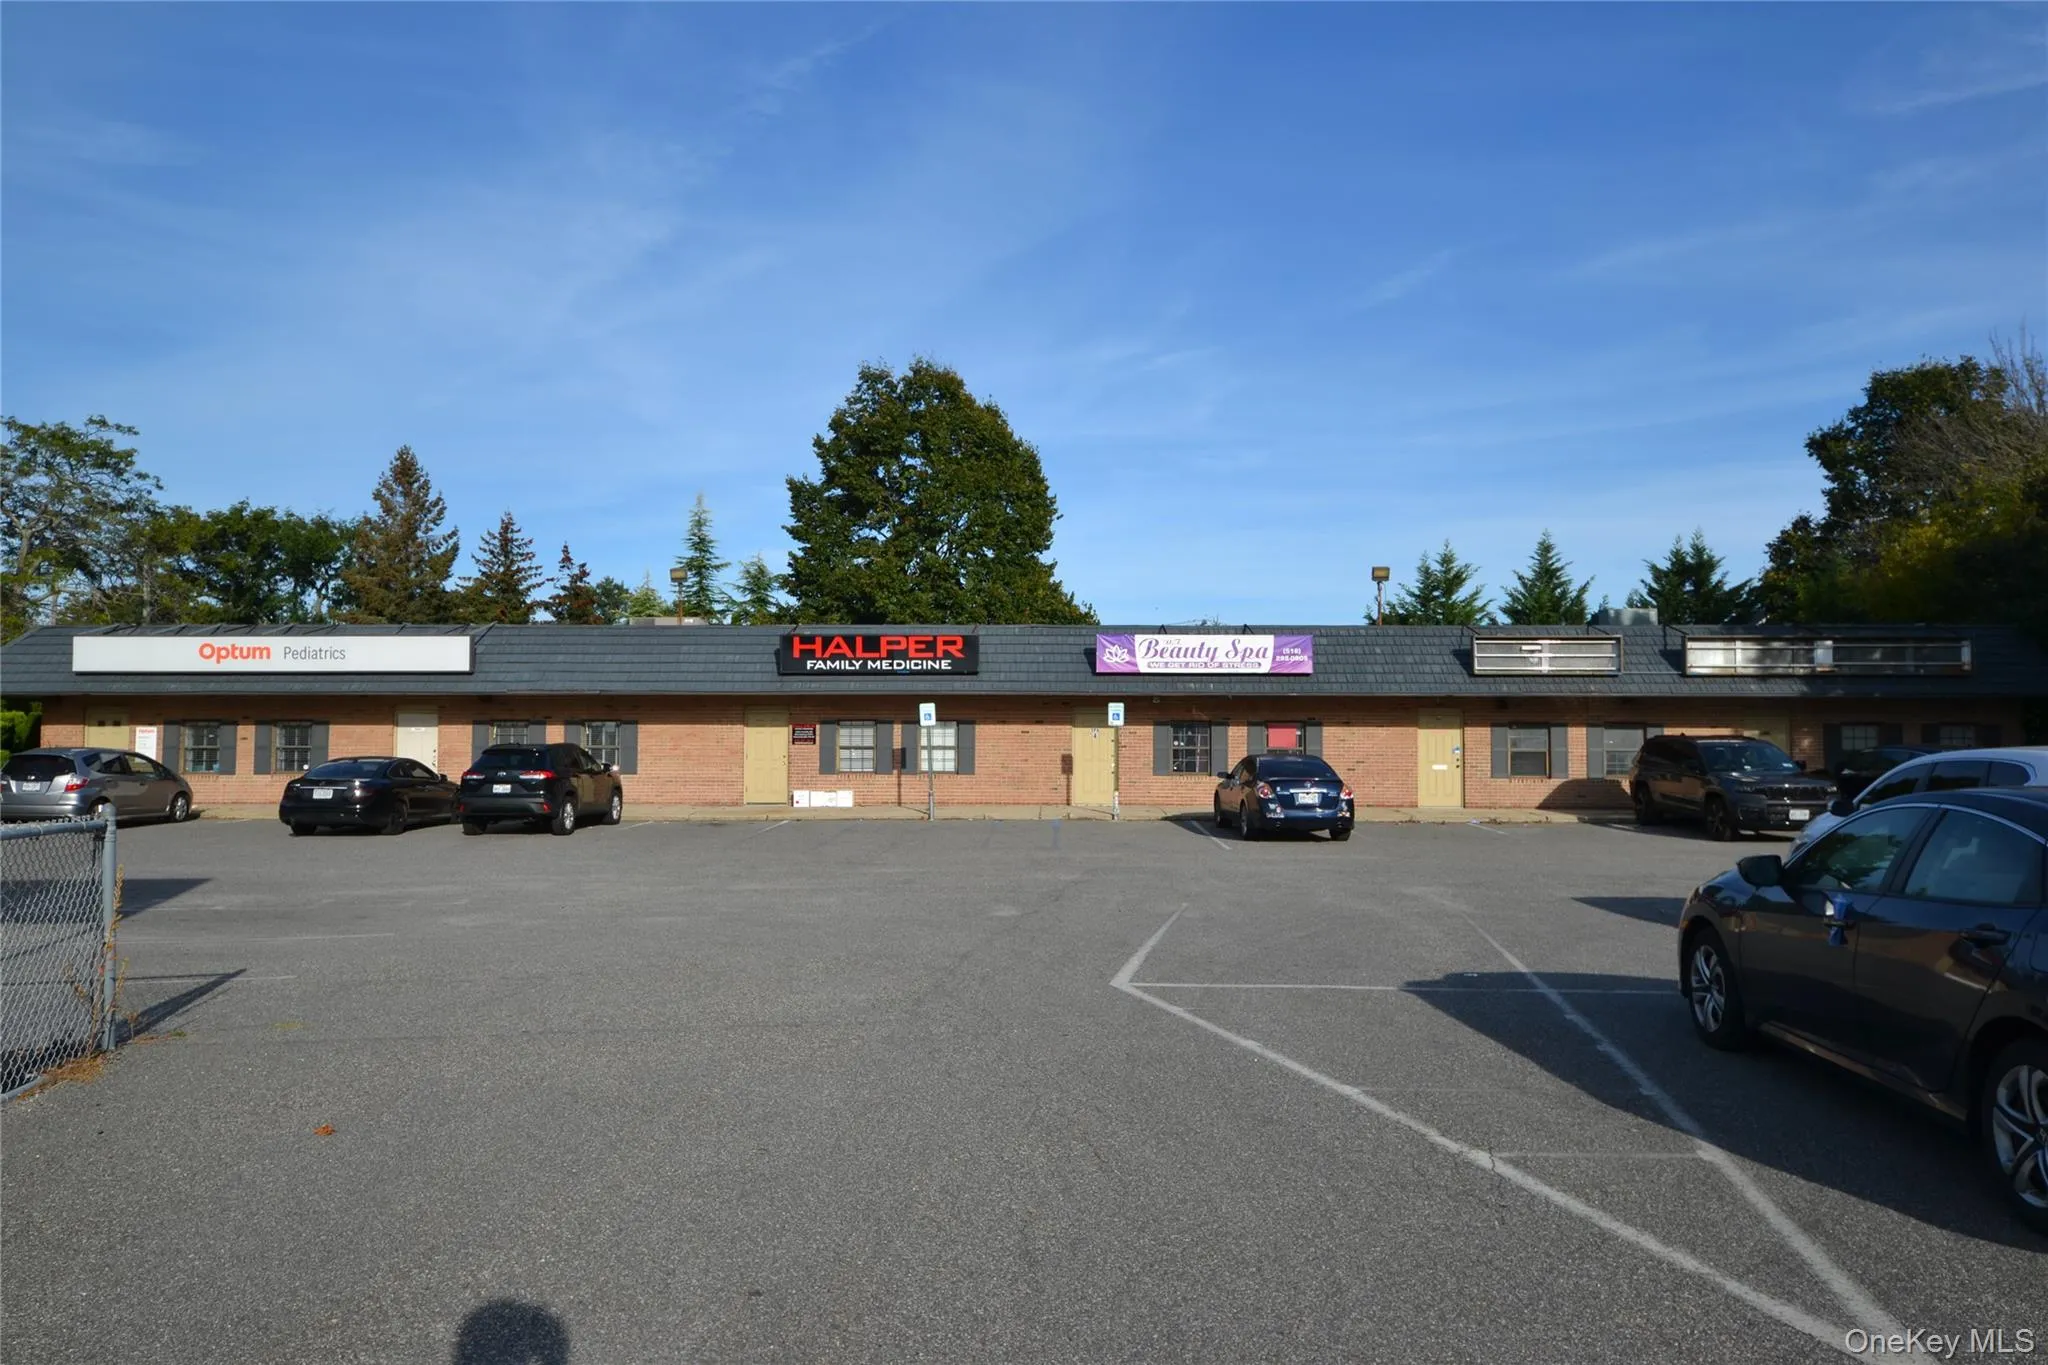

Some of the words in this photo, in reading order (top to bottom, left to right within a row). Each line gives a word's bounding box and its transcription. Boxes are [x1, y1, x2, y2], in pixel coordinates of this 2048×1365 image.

[199, 642, 271, 664] Optum
[283, 646, 346, 660] Pediatrics
[793, 635, 965, 658] HALPER
[1138, 637, 1218, 663] Beauty
[1225, 638, 1269, 663] Spa
[806, 660, 863, 670] FAMILY
[867, 660, 952, 670] MEDICINE
[1149, 661, 1165, 669] WE
[1168, 661, 1185, 669] GET
[1188, 661, 1205, 669] RID
[1207, 661, 1220, 669] OF
